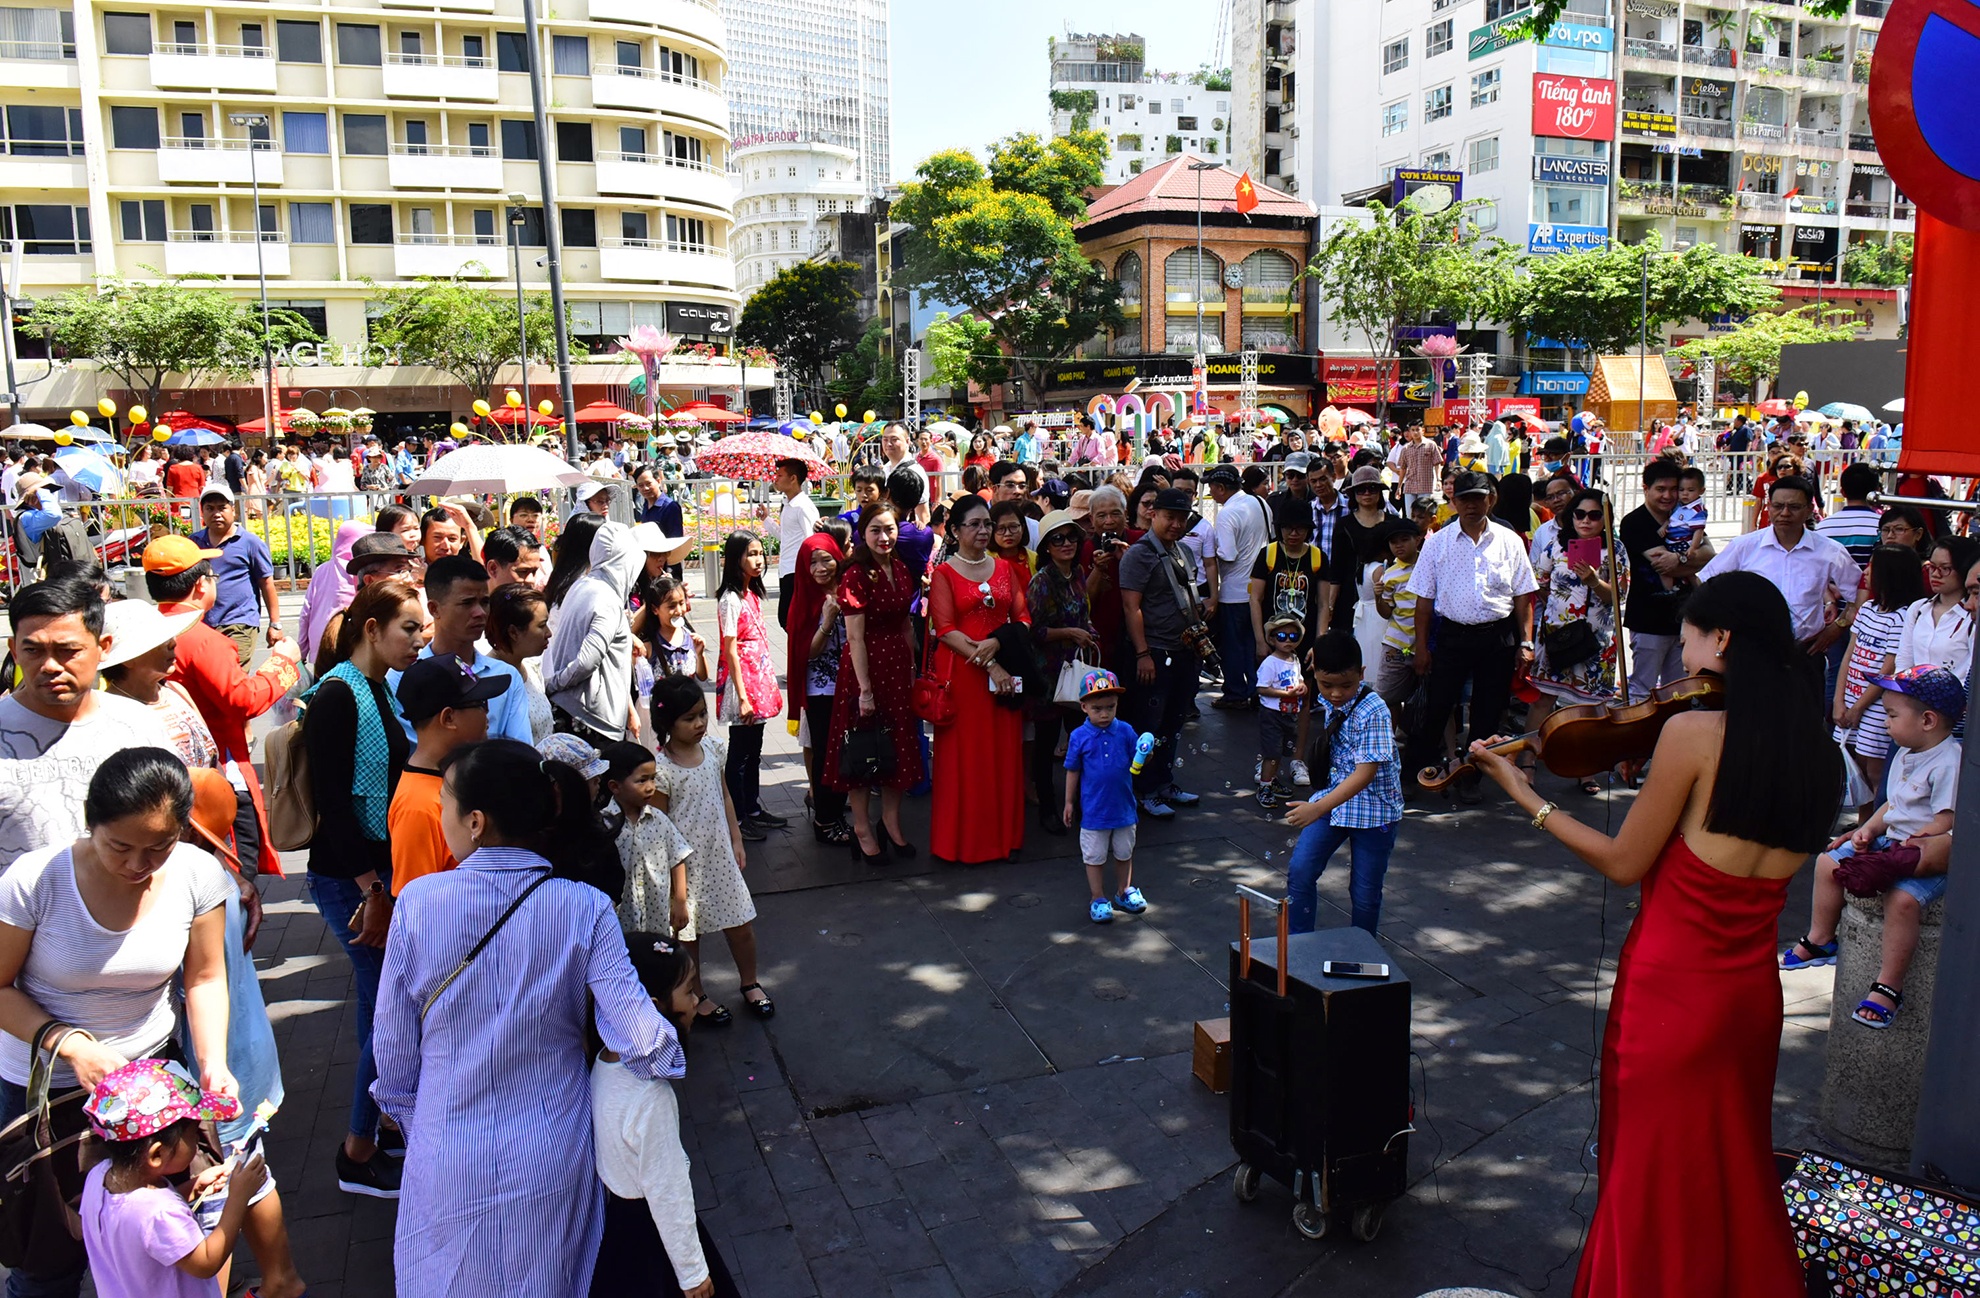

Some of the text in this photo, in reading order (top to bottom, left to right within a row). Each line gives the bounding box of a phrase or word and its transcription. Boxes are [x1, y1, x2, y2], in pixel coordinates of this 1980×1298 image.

[1538, 78, 1578, 106] Tiếng
[1555, 106, 1585, 127] 180
[743, 131, 799, 147] SATRA GROUP
[1543, 159, 1608, 176] LANCASTER
[1742, 156, 1783, 173] DOSH
[1440, 173, 1461, 182] CALI
[1555, 174, 1594, 182] LINCOLN
[1677, 206, 1707, 217] COFFEE
[1556, 229, 1607, 246] Expertise
[679, 308, 729, 321] calibre
[1103, 365, 1137, 378] HOANG PHUC
[1206, 364, 1243, 374] HOANG
[1057, 371, 1086, 382] HOANG PHUC
[1536, 376, 1584, 391] honor
